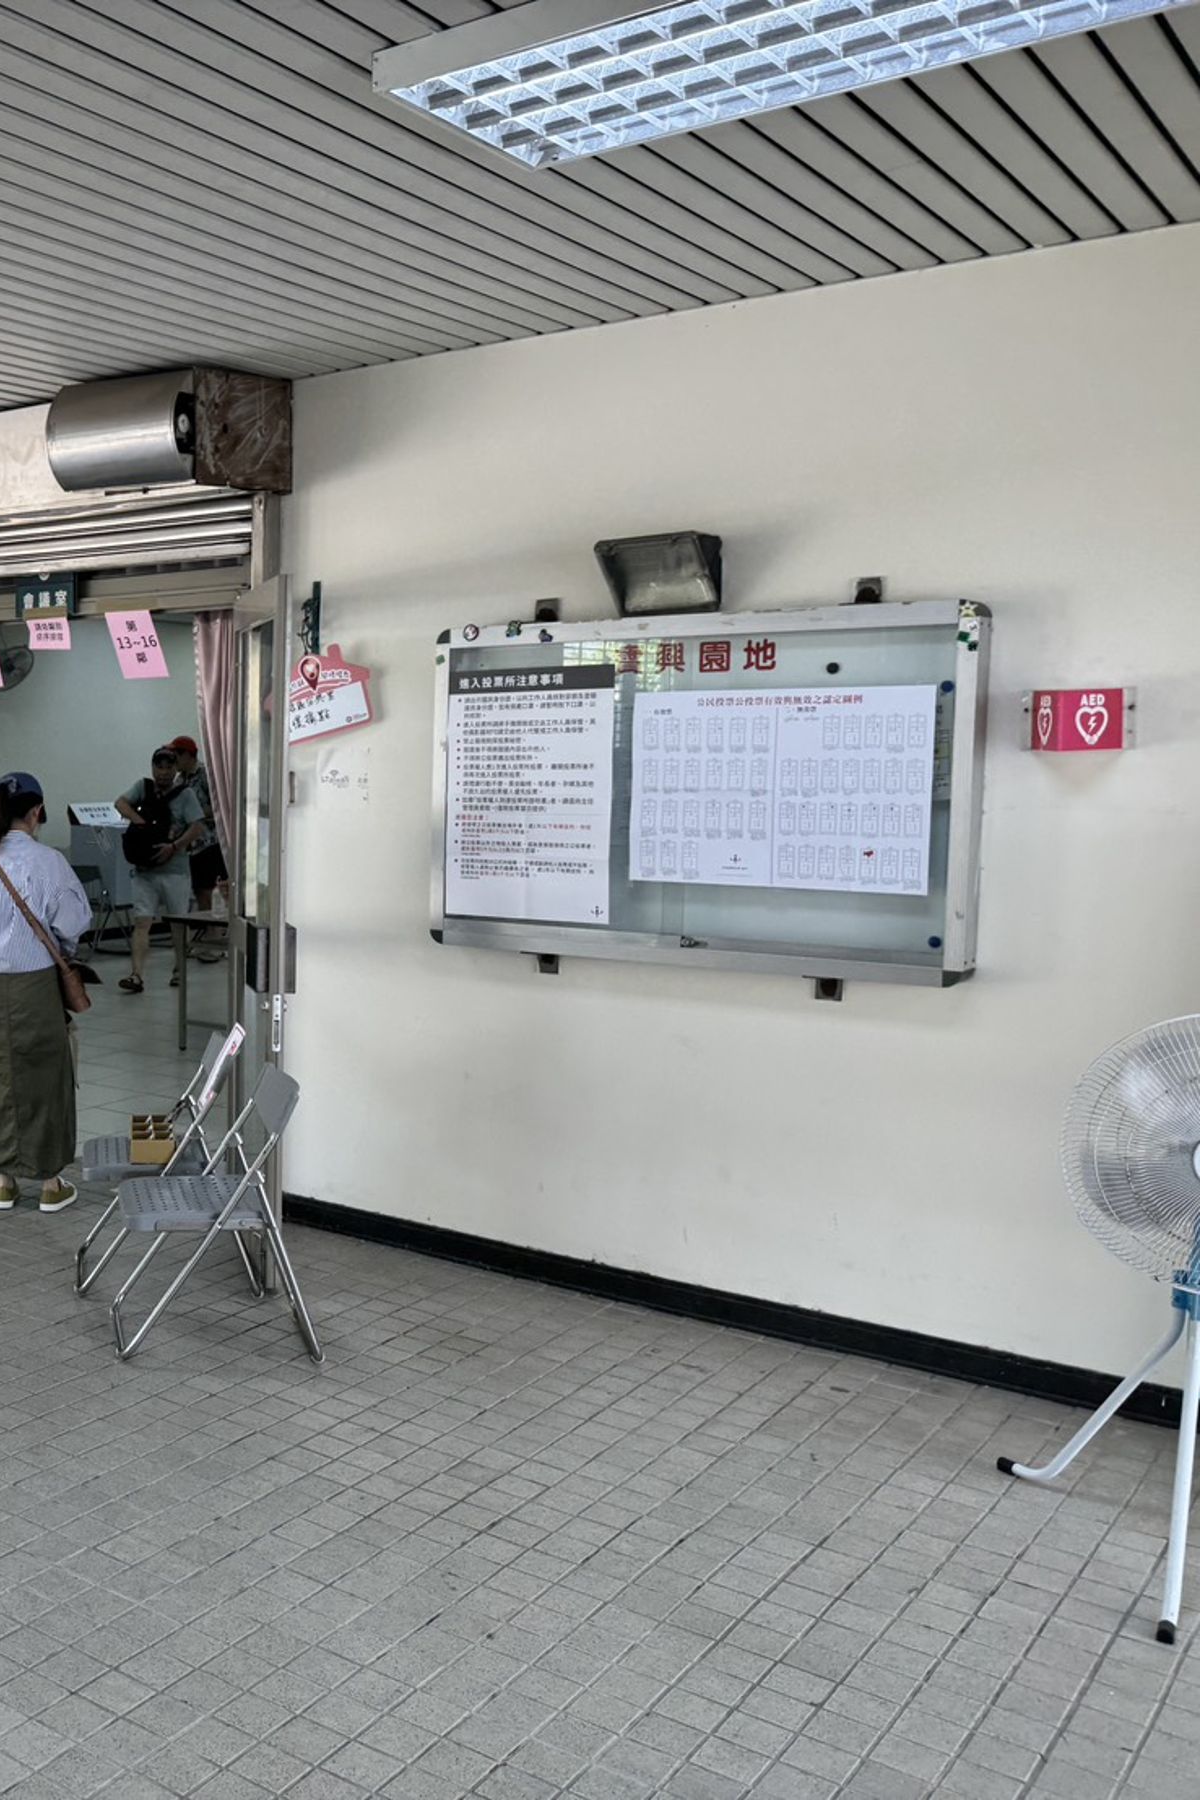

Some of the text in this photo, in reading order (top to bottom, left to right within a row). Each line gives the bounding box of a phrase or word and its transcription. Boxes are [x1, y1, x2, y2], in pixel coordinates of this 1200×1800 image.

[23, 590, 68, 609] 會議室
[125, 620, 138, 632] 第
[117, 635, 158, 649] 13~16
[459, 673, 564, 690] 進入投票所注意事項
[1080, 693, 1105, 706] AED
